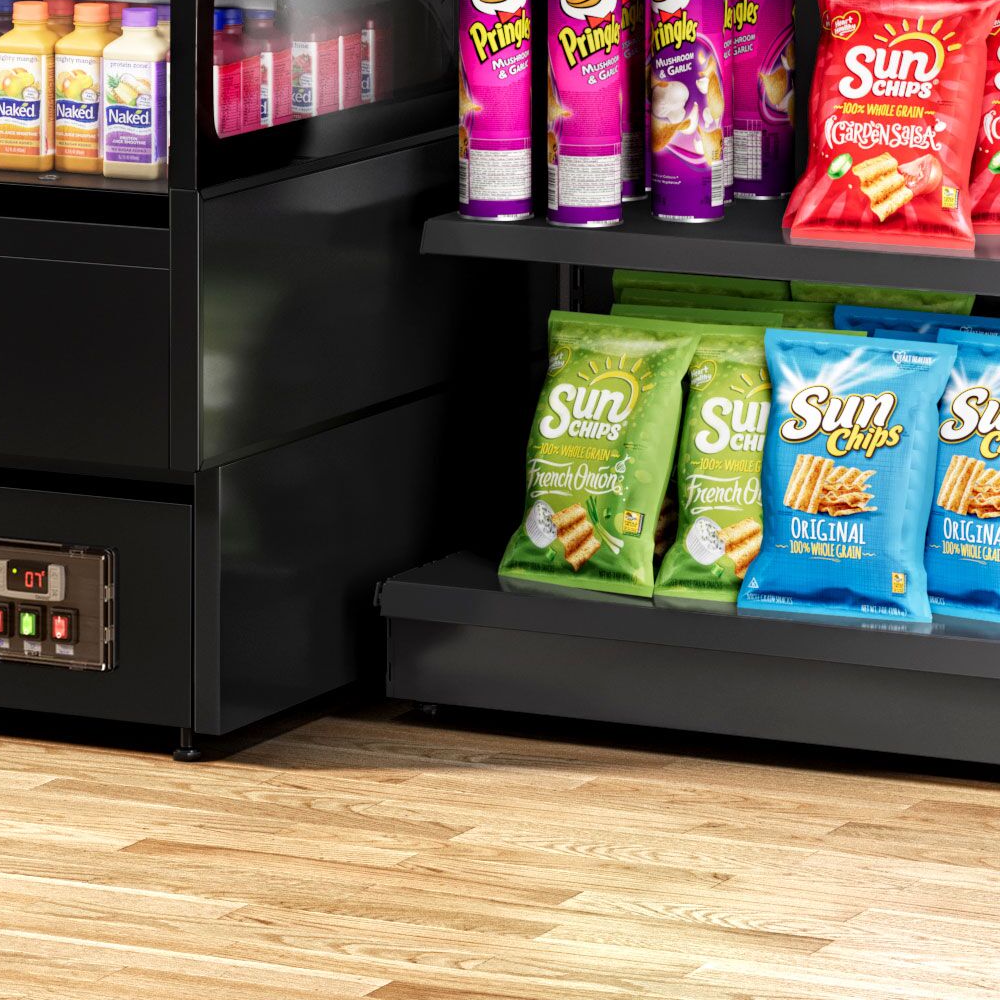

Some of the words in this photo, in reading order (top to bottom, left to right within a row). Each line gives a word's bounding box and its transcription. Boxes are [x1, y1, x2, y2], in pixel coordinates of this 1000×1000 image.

[833, 15, 854, 29] Heart
[655, 51, 695, 69] MUSHROOM
[498, 70, 507, 80] &
[588, 74, 597, 85] &
[658, 69, 667, 79] &
[667, 62, 692, 77] GARLIC
[838, 44, 940, 100] Sun
[872, 79, 934, 100] CHIPS
[56, 103, 95, 120] Naked
[108, 108, 150, 126] Naked
[842, 102, 866, 114] 100%
[866, 103, 895, 117] WHOLE
[895, 105, 926, 118] GRAIN
[539, 382, 634, 440] Sun
[779, 385, 898, 444] Sun
[568, 420, 623, 441] CHIPS
[826, 422, 903, 458] Chips
[540, 443, 560, 456] 100%
[560, 444, 587, 459] WHOLE
[586, 447, 611, 462] GRAIN
[699, 457, 722, 470] 100%
[724, 459, 754, 472] WHOLE
[527, 458, 573, 491] French
[573, 462, 623, 495] Onion
[685, 473, 743, 507] French
[790, 516, 866, 545] ORIGINAL
[943, 516, 1000, 546] ORIGINA
[789, 539, 811, 555] 100%
[811, 541, 836, 558] WHOLE
[836, 543, 862, 560] GRAIN
[941, 540, 960, 555] 100%
[960, 543, 983, 559] WHOLE
